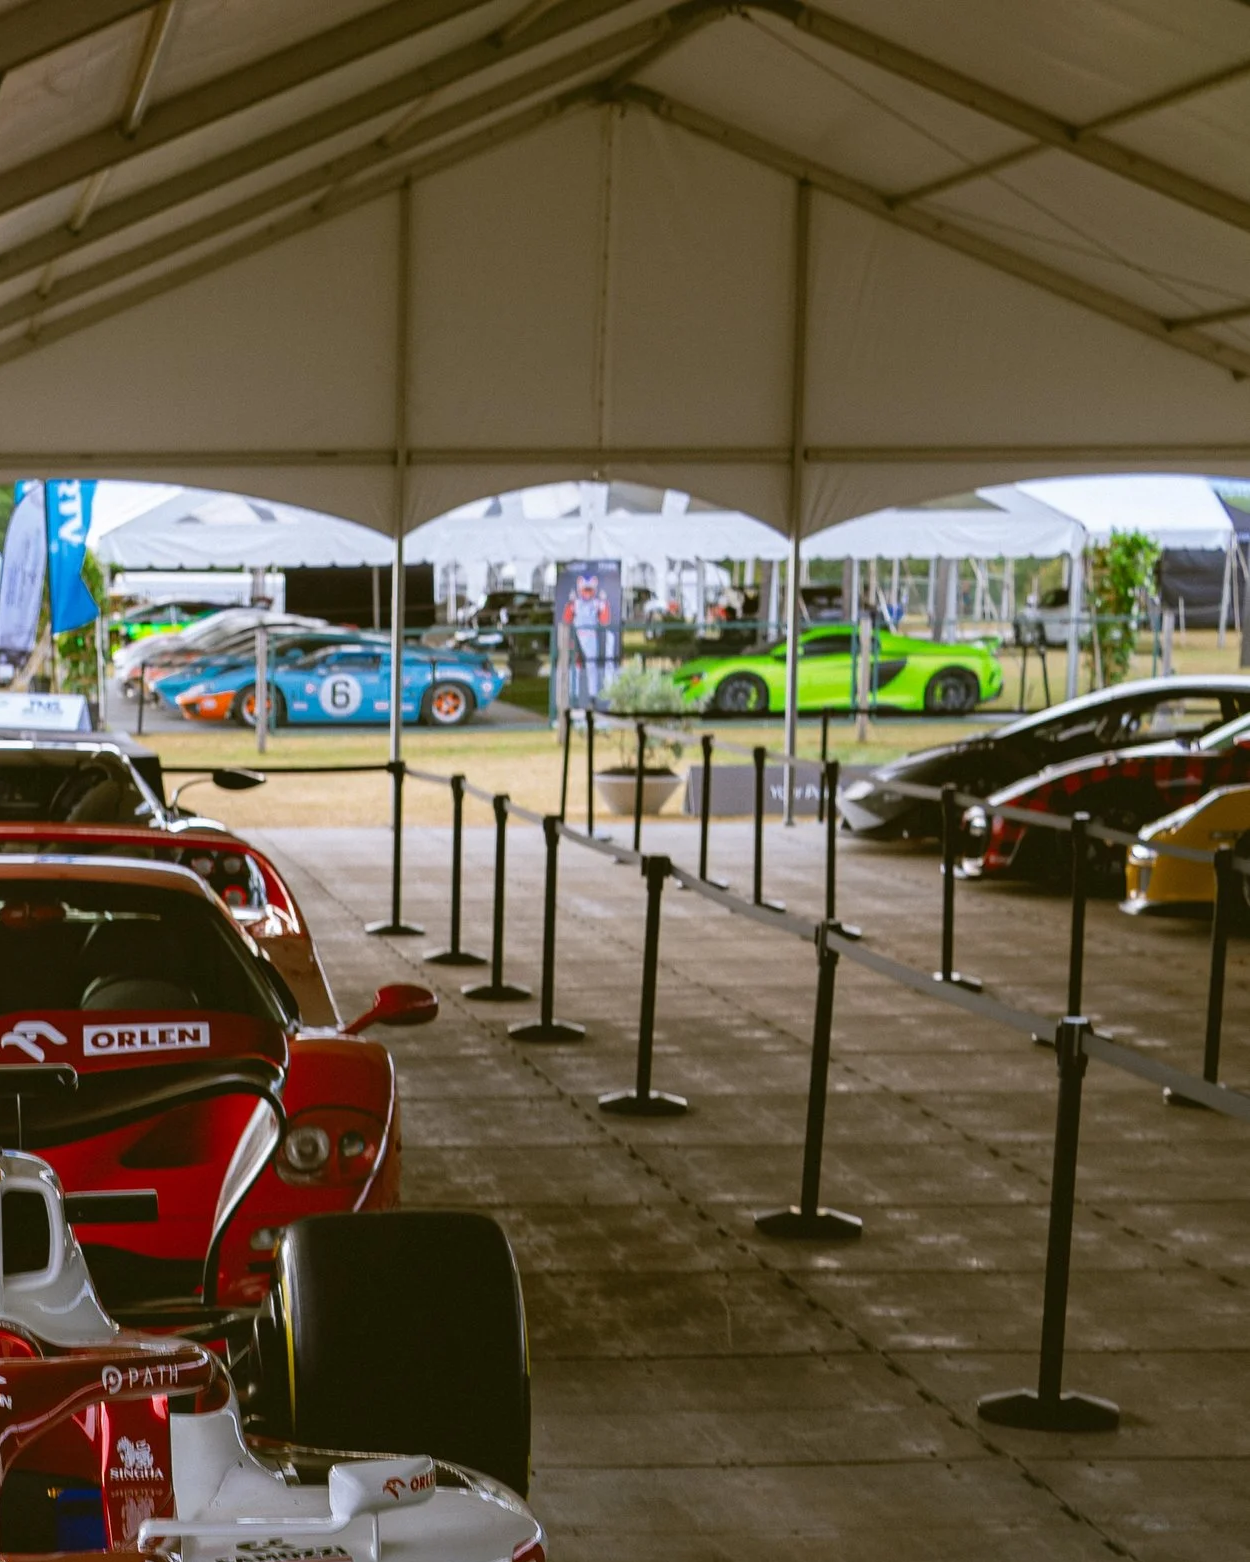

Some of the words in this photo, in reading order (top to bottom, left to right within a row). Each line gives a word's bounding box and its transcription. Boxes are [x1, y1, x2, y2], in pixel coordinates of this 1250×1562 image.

[331, 680, 351, 710] 6
[89, 1023, 206, 1052] ORLEN
[128, 1364, 179, 1389] PATH
[110, 1466, 165, 1481] SINGHA
